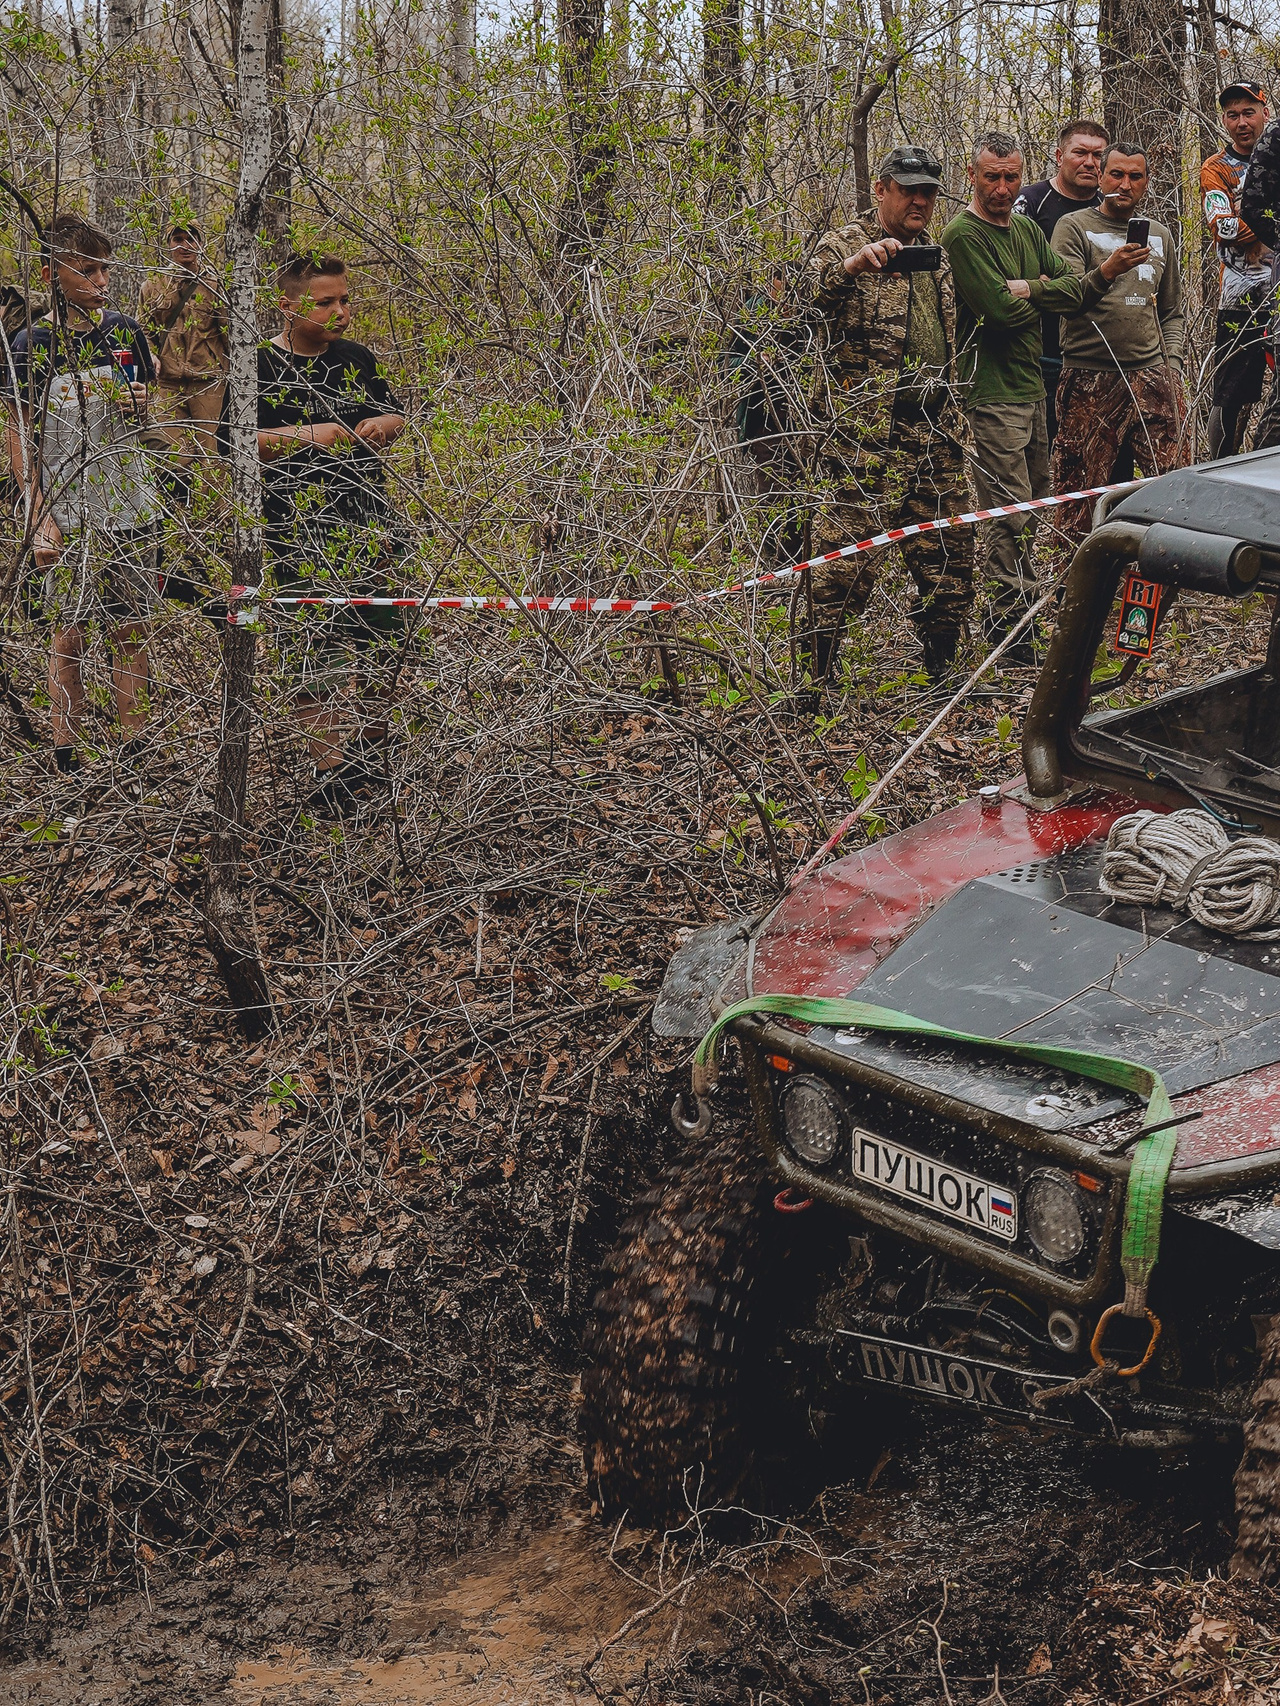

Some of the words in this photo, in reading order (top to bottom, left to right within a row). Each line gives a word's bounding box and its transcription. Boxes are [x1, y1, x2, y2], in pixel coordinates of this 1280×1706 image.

[1130, 580, 1156, 606] R1
[858, 1138, 987, 1223] ПУШОК
[991, 1213, 1013, 1234] RUS
[860, 1342, 1004, 1406] ПУШОК
